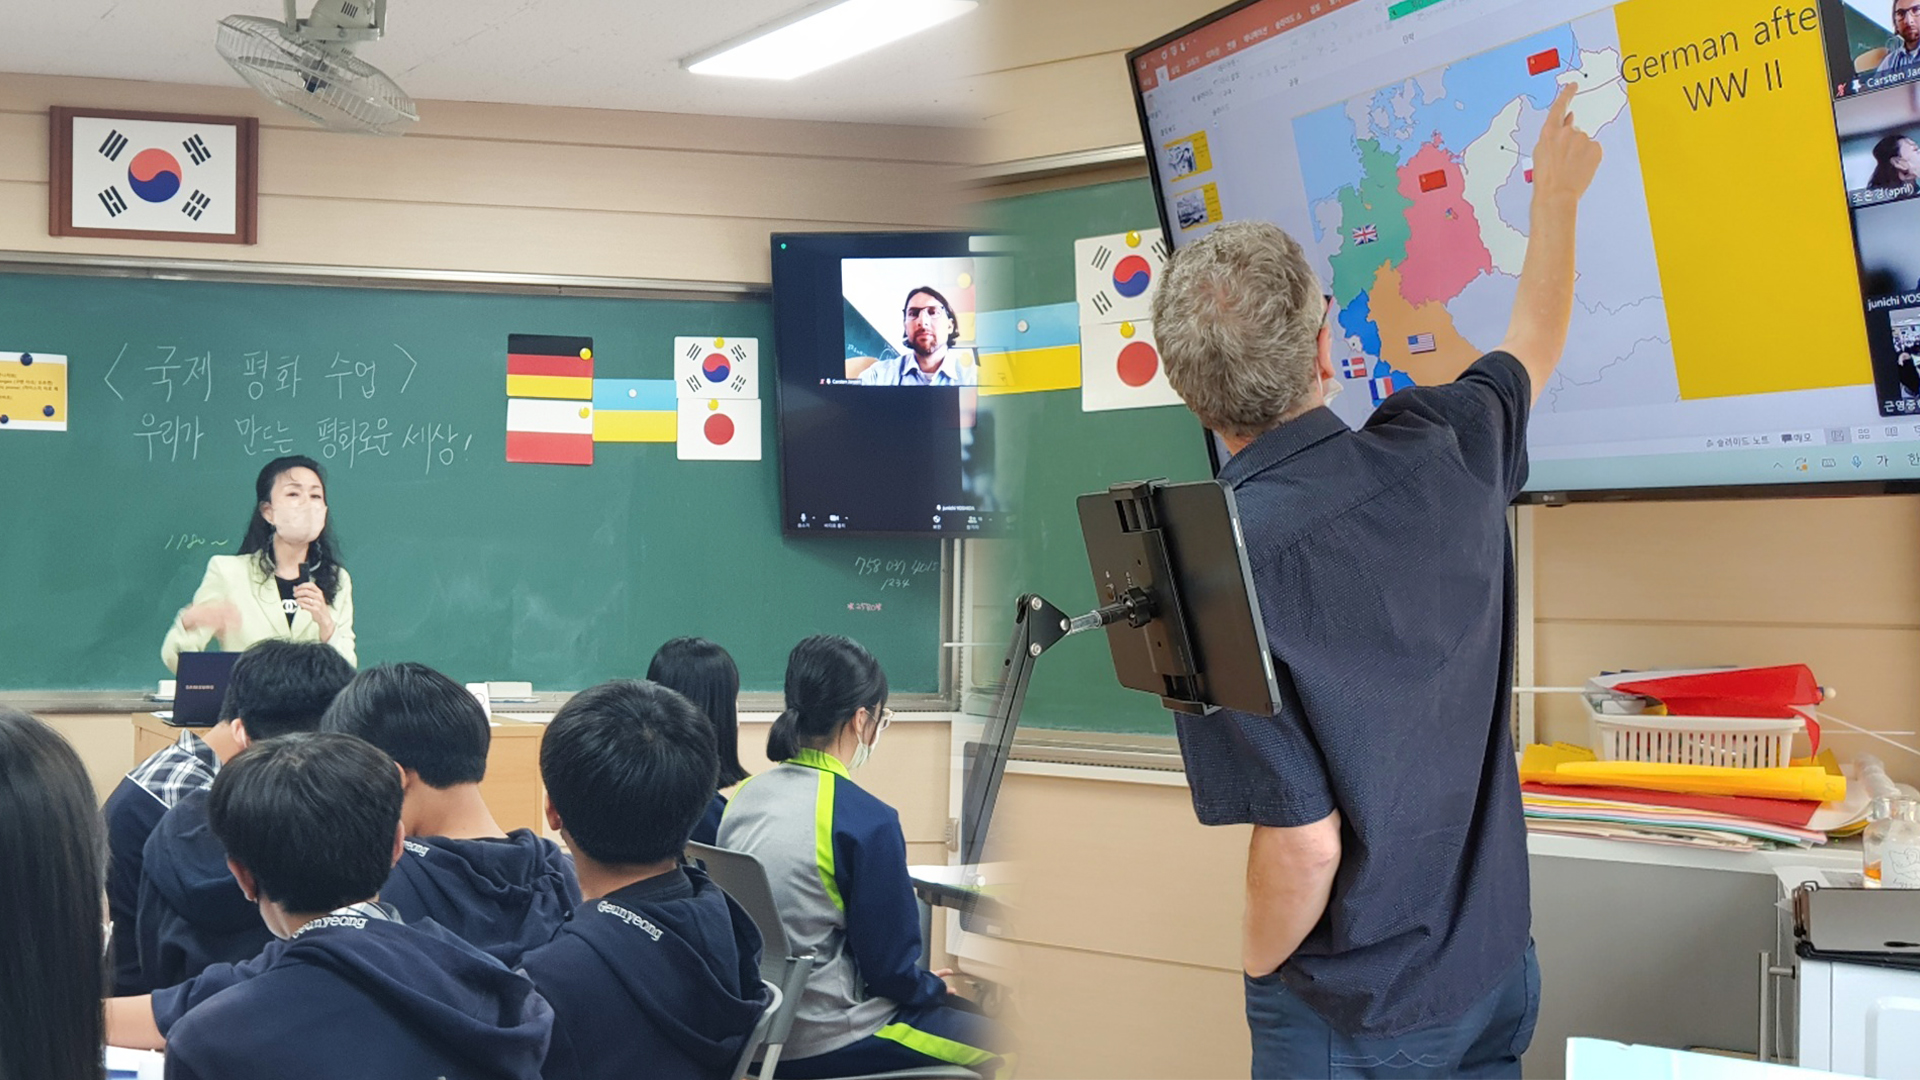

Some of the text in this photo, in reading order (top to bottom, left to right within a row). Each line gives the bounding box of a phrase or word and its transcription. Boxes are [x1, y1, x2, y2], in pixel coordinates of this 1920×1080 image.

[1620, 6, 1818, 84] German afte
[1682, 59, 1783, 111] WW II
[1866, 71, 1905, 88] Carsten
[1867, 295, 1900, 311] junichi
[144, 346, 211, 402] 국제
[243, 350, 302, 400] 평화
[325, 351, 376, 399] 수업
[1883, 399, 1920, 413] 근영중
[133, 412, 204, 462] 우리가
[234, 414, 293, 455] 만드는
[317, 416, 393, 469] 평화로운
[1717, 435, 1770, 448] 슬라이드 노트
[1793, 432, 1812, 443] 메모
[1876, 454, 1888, 467] 가
[855, 556, 882, 575] 758
[880, 578, 910, 591] 1234
[596, 900, 664, 942] Geunyeong
